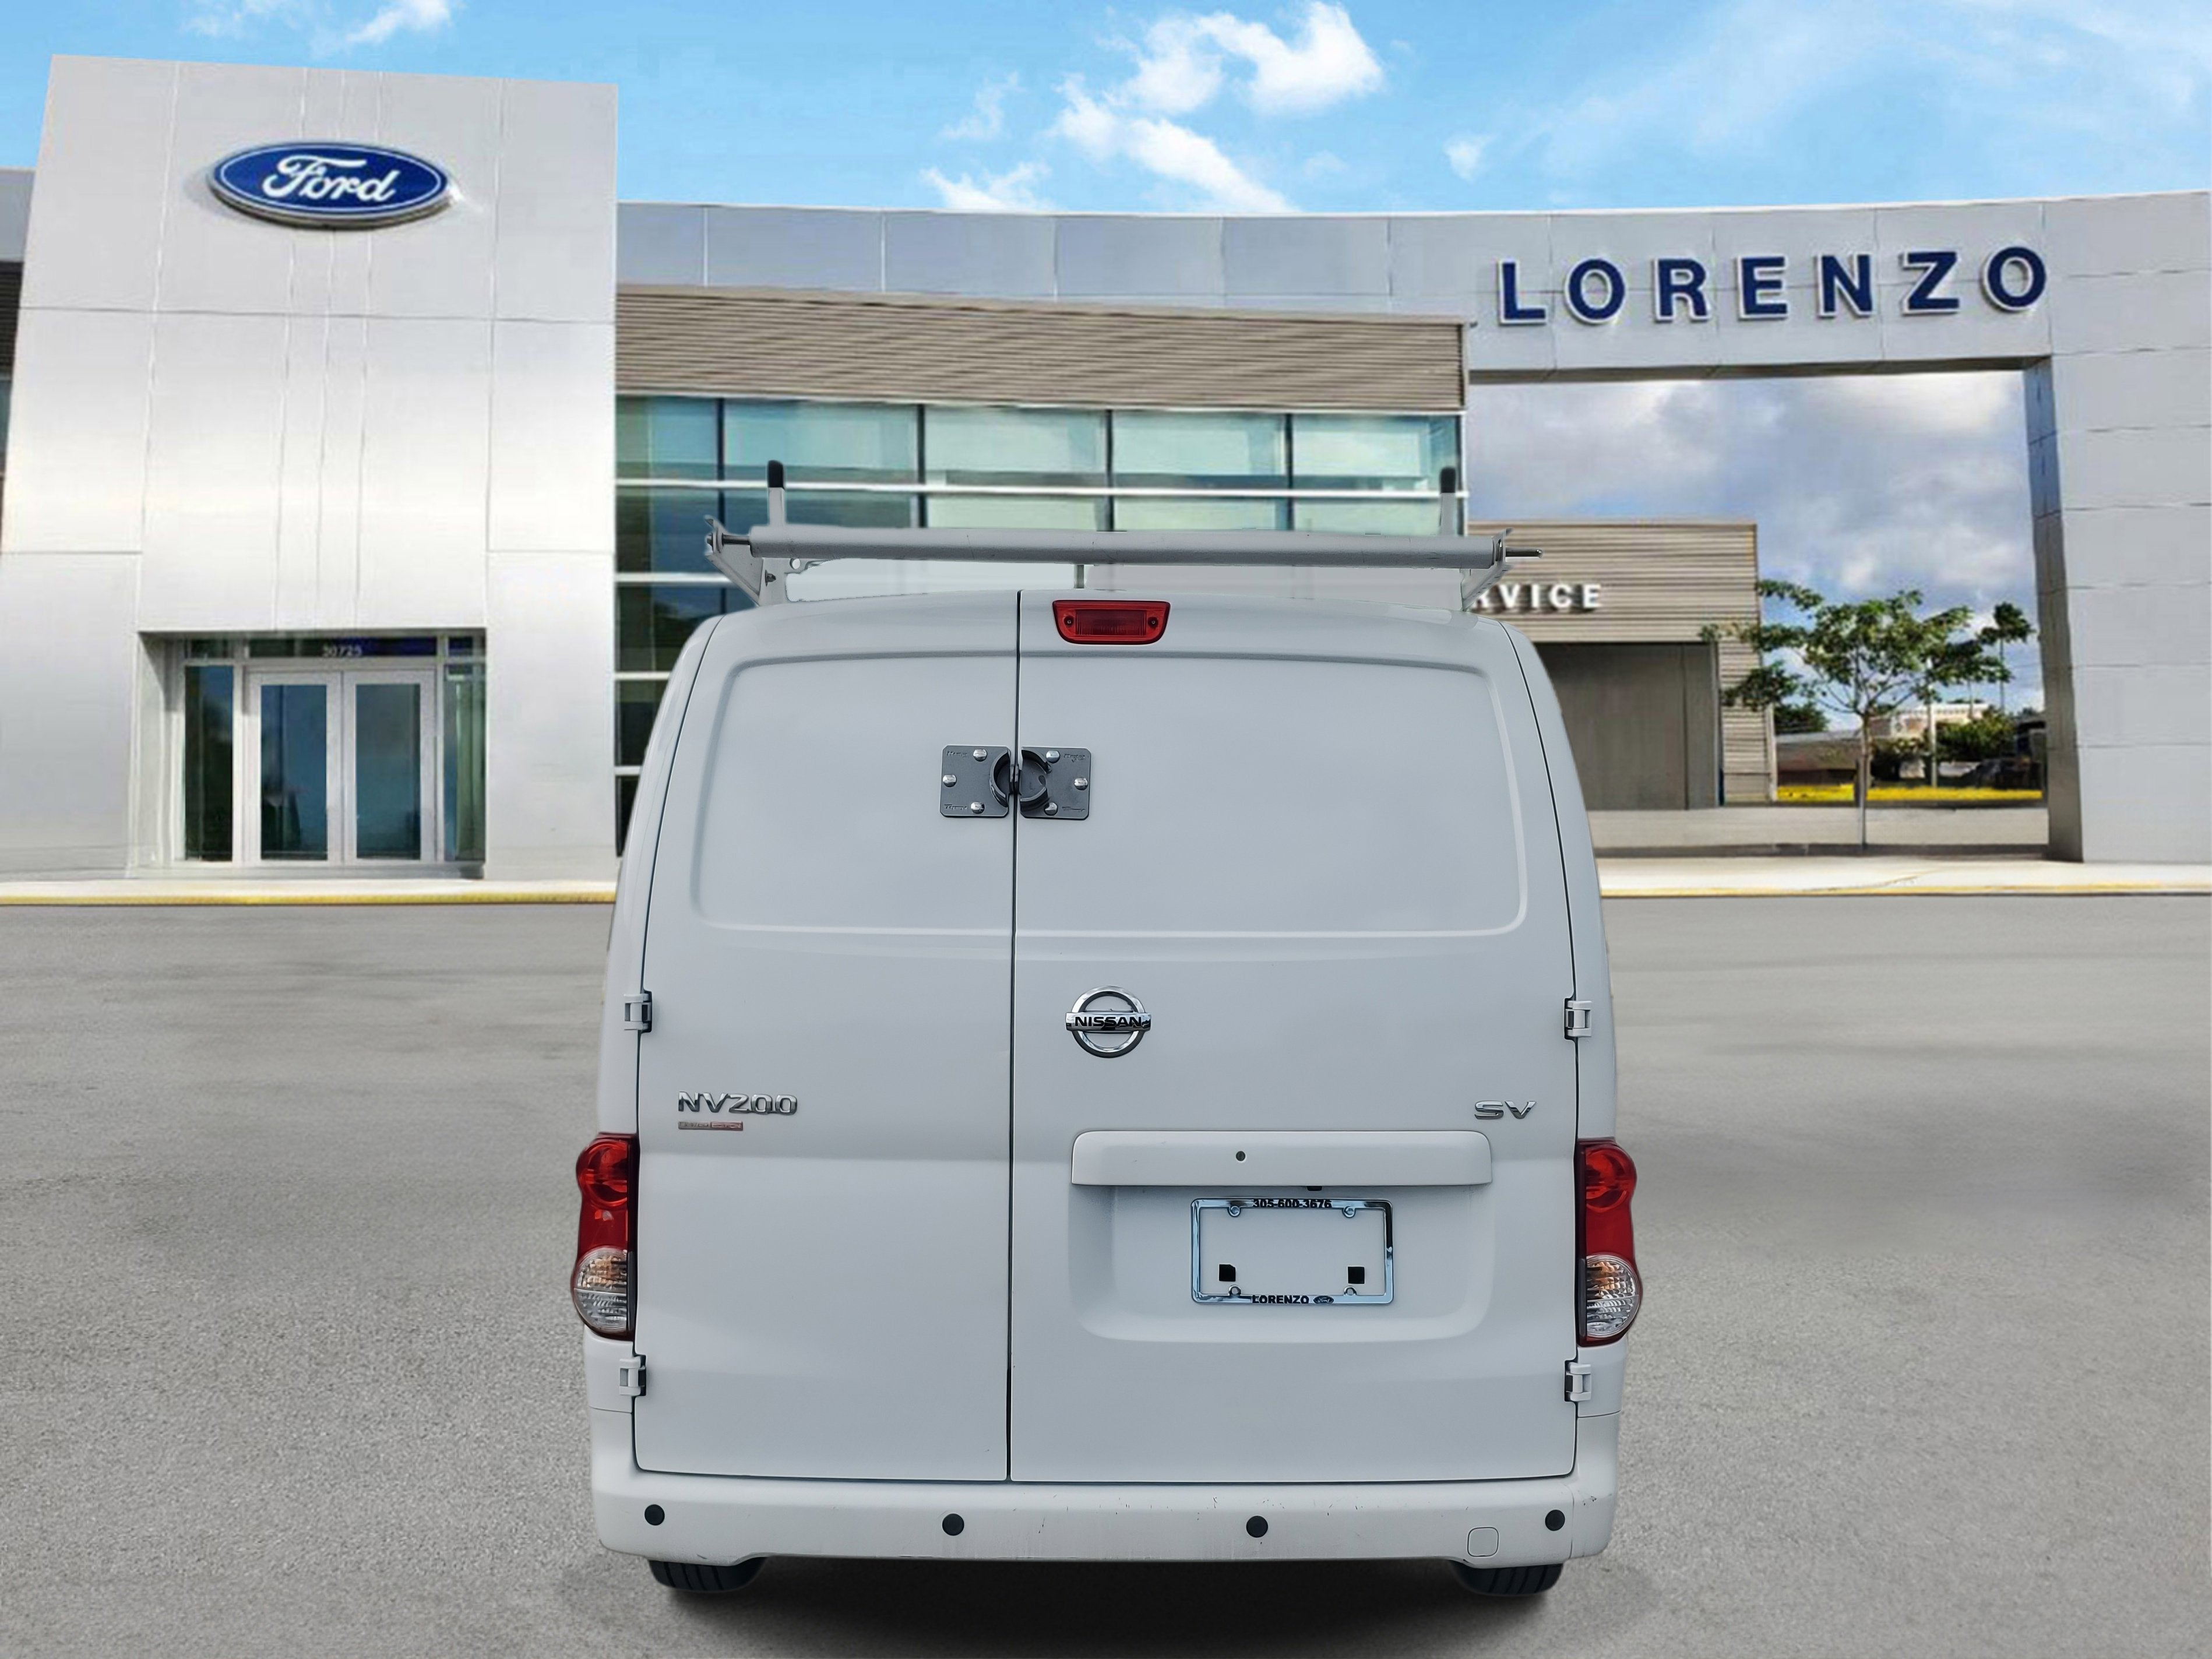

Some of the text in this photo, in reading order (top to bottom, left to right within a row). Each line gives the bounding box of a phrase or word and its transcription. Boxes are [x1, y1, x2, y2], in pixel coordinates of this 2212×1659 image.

[263, 155, 400, 201] Ford
[1498, 246, 2046, 323] LORENZO
[1075, 1016, 1143, 1027] NISSAN
[678, 1091, 798, 1115] NV200
[1474, 1100, 1537, 1119] SV
[1252, 1199, 1333, 1208] 305-600-3676
[1252, 1295, 1309, 1304] LORENZO
